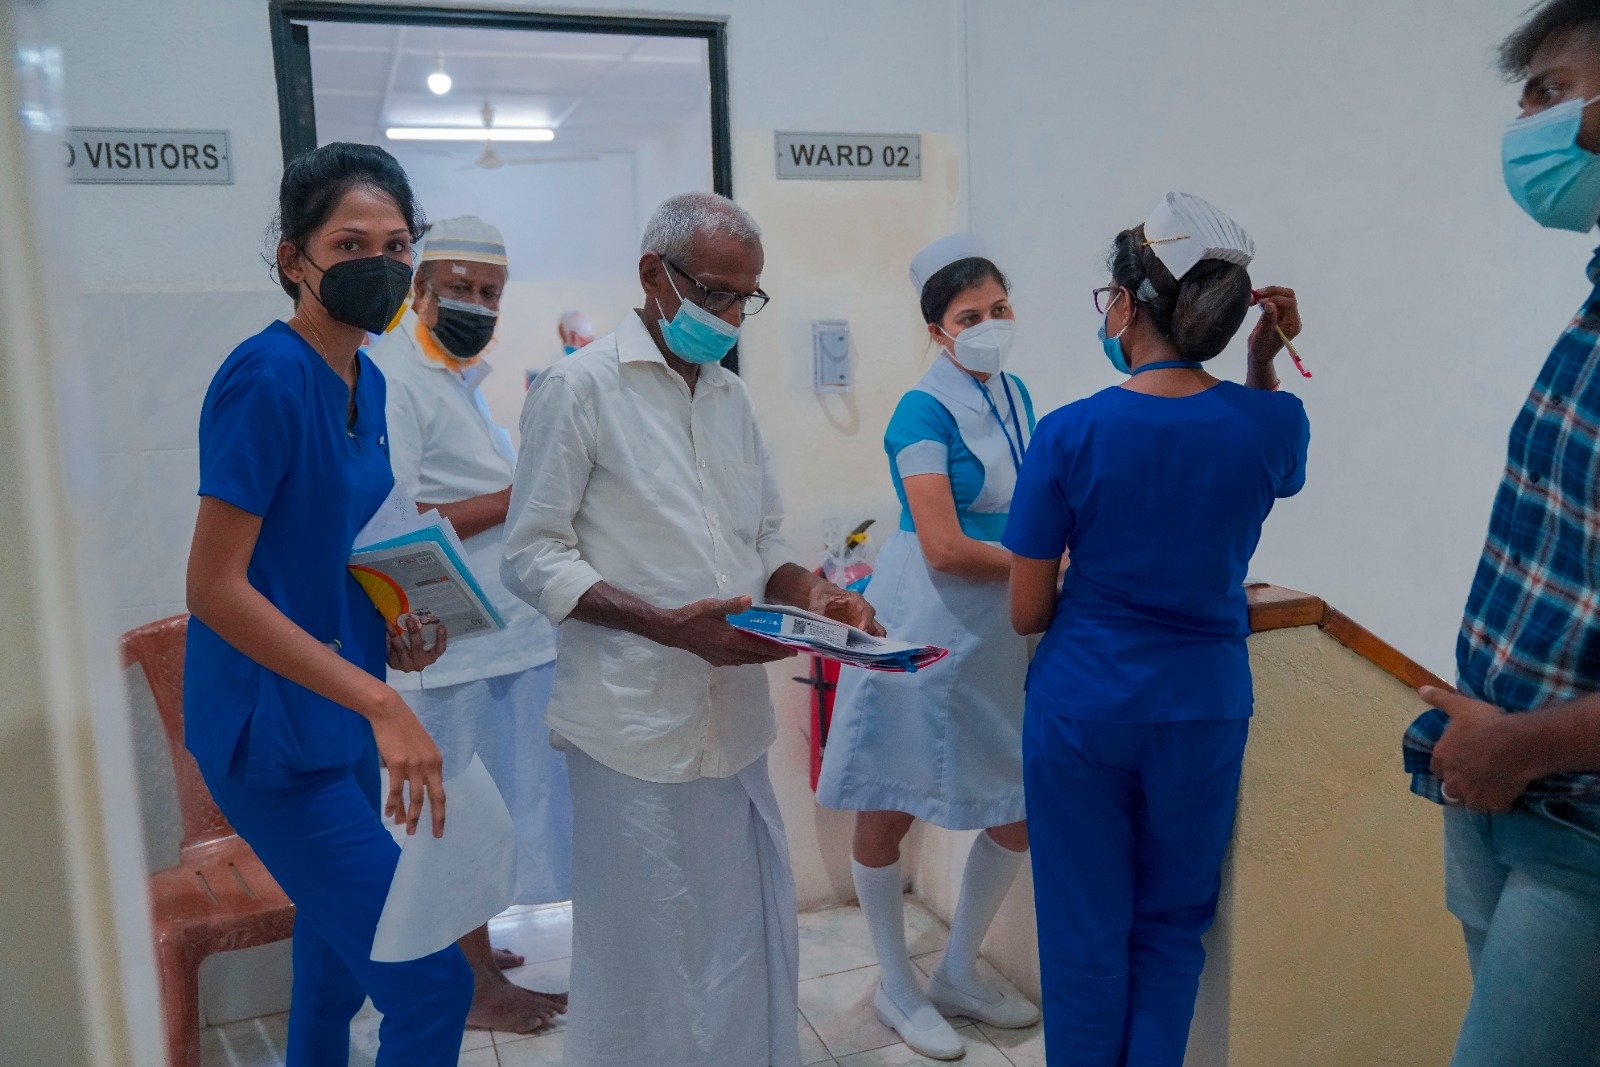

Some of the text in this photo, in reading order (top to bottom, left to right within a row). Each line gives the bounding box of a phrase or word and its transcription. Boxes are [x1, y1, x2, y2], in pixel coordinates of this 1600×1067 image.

[84, 141, 219, 170] VISITORS
[790, 144, 910, 168] WARD 02
